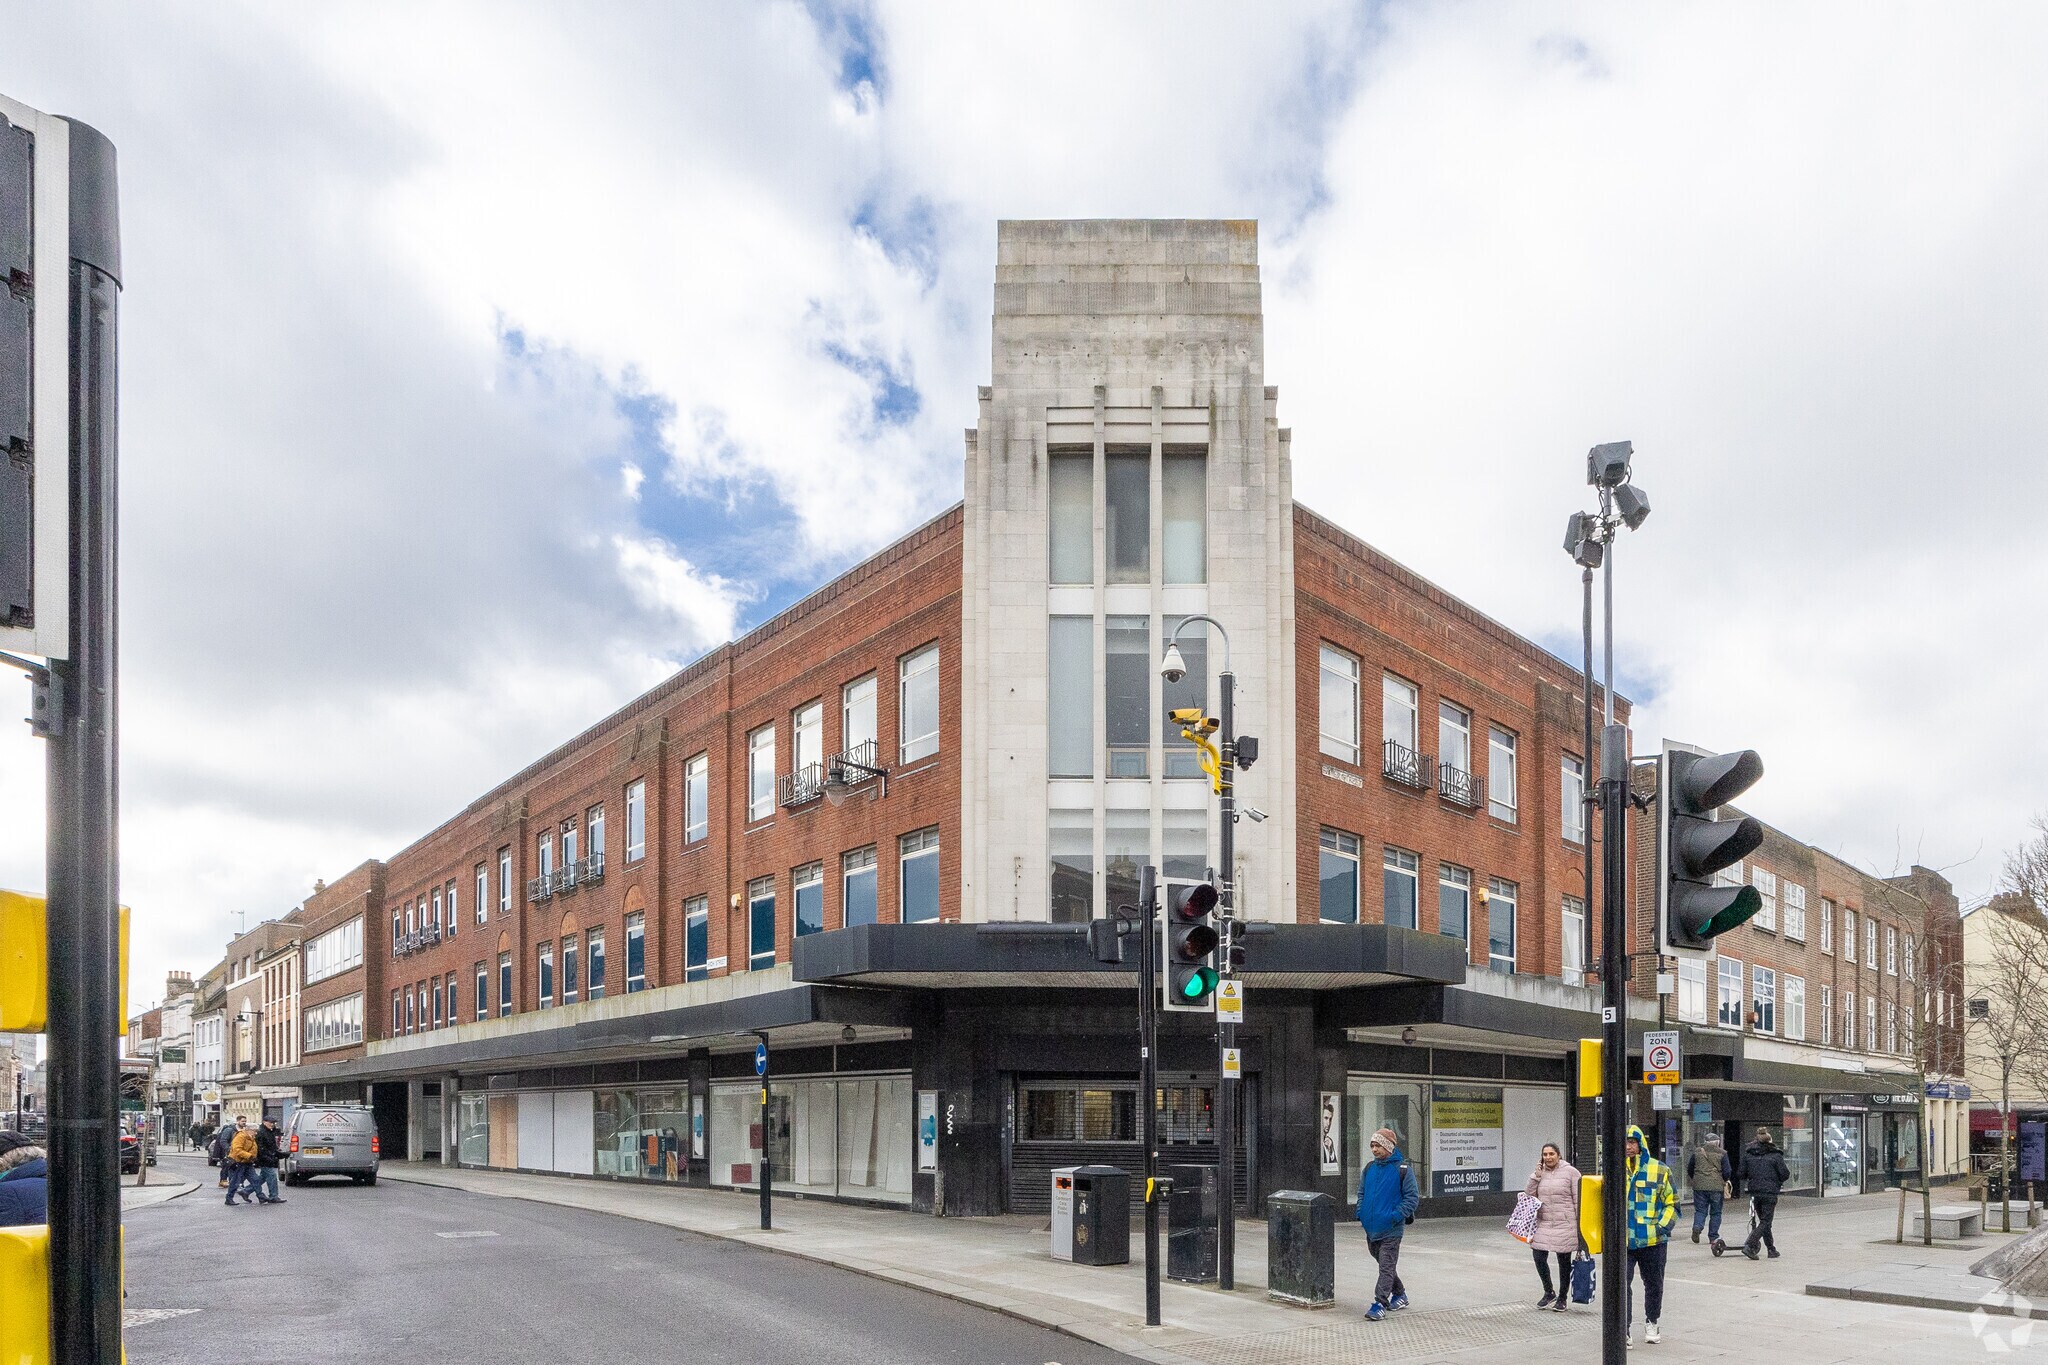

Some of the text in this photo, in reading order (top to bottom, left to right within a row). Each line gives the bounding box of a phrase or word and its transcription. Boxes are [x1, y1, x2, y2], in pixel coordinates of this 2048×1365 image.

[1604, 1009, 1612, 1021] 5
[1649, 1037, 1673, 1045] ZONE
[1444, 1172, 1490, 1184] 01234 905128
